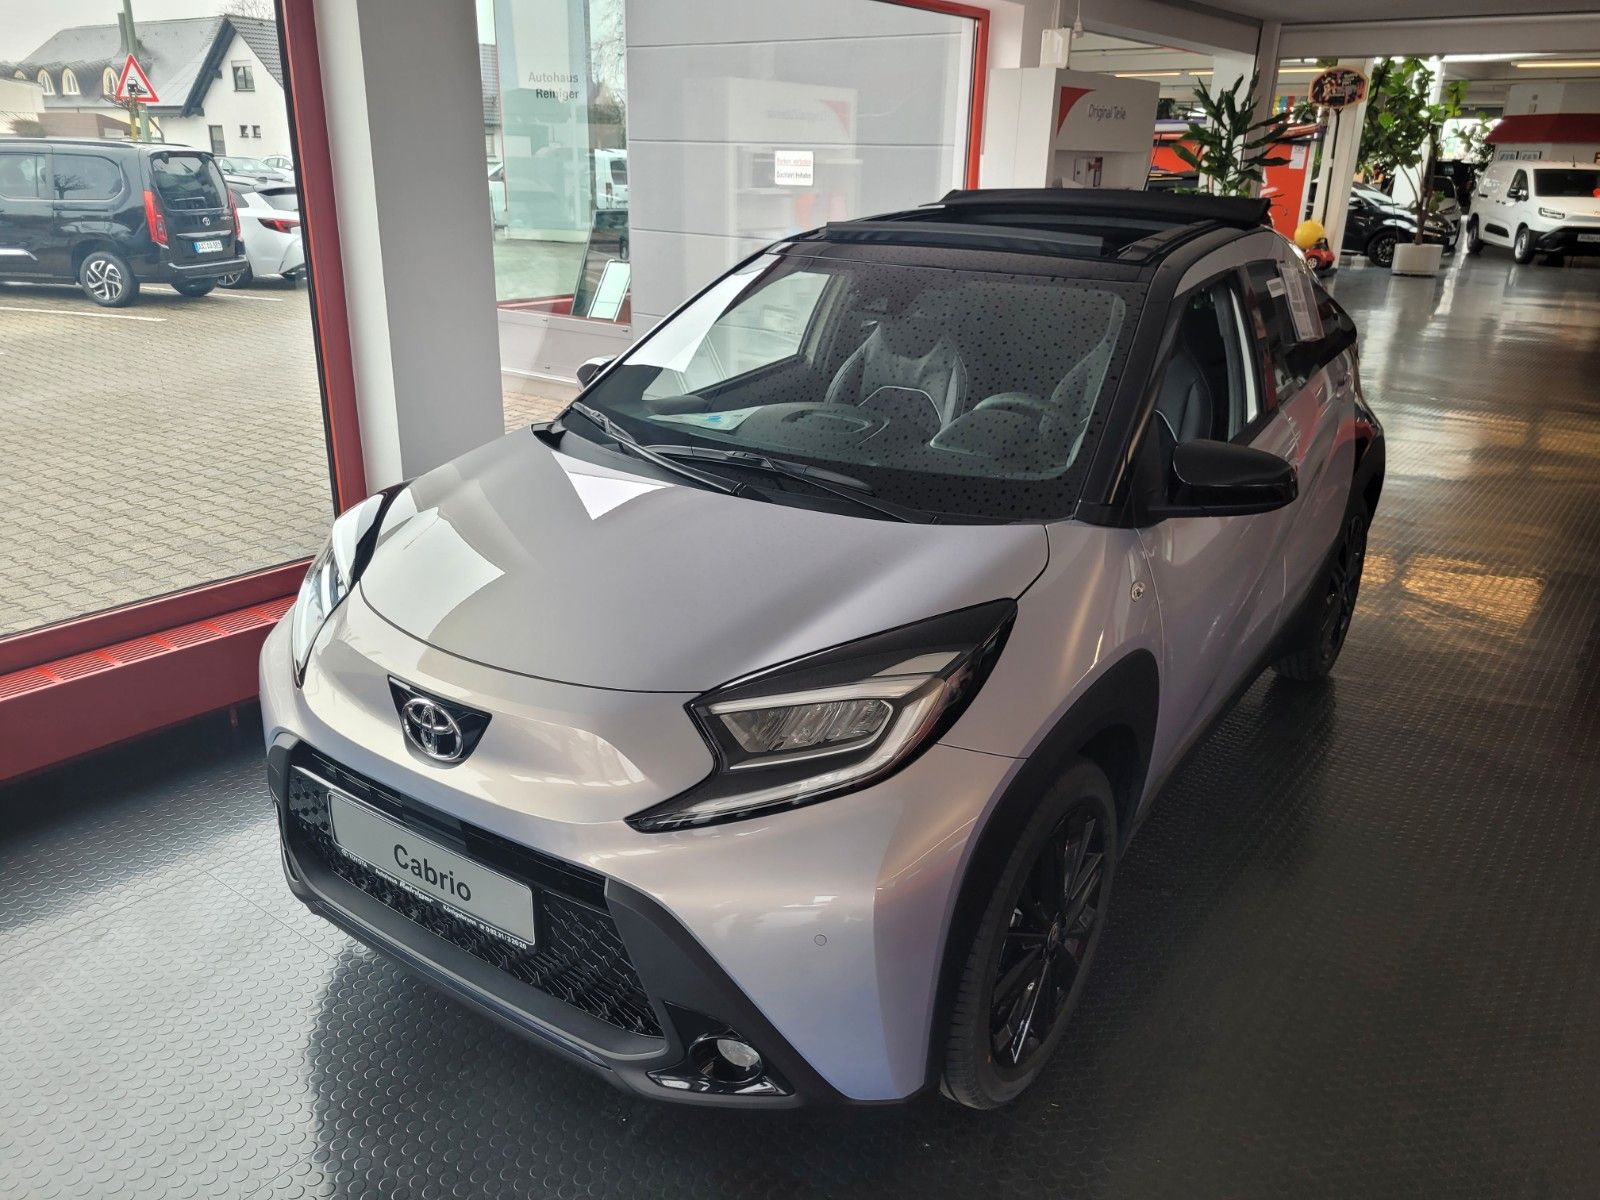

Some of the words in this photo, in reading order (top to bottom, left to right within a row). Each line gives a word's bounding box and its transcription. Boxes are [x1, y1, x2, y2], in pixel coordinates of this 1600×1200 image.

[529, 72, 579, 83] Autohaus
[536, 88, 579, 101] Reiniger
[1088, 104, 1113, 121] Original
[1114, 106, 1127, 120] Teile
[393, 843, 472, 902] Cabrio
[400, 881, 435, 903] Reiniger
